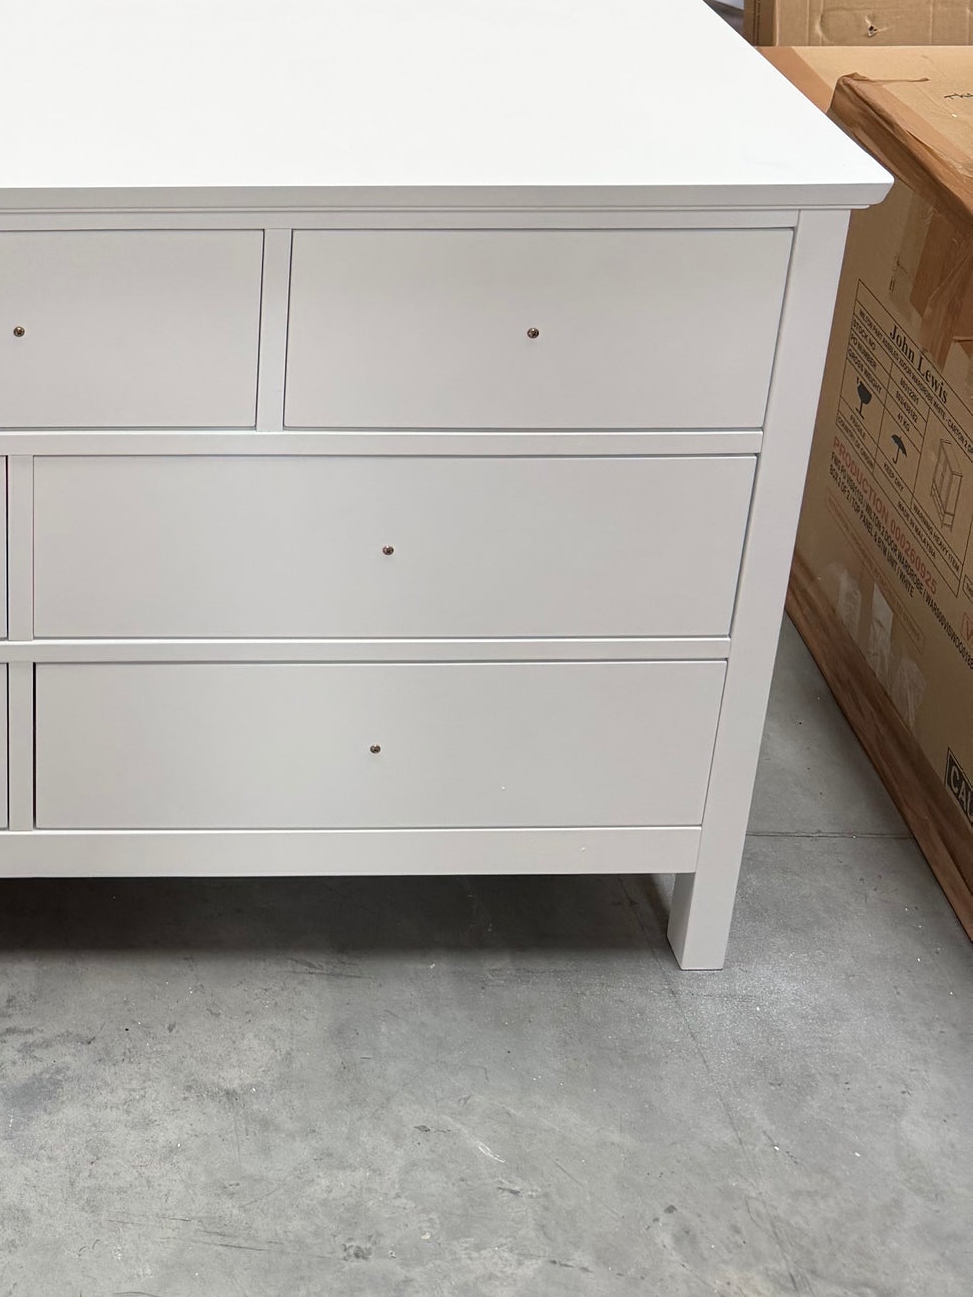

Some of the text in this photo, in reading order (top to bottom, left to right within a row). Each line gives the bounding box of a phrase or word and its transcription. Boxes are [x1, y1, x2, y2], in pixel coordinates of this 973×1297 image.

[890, 325, 914, 363] John
[917, 355, 947, 403] Lewis
[833, 436, 888, 527] PRODUCTION
